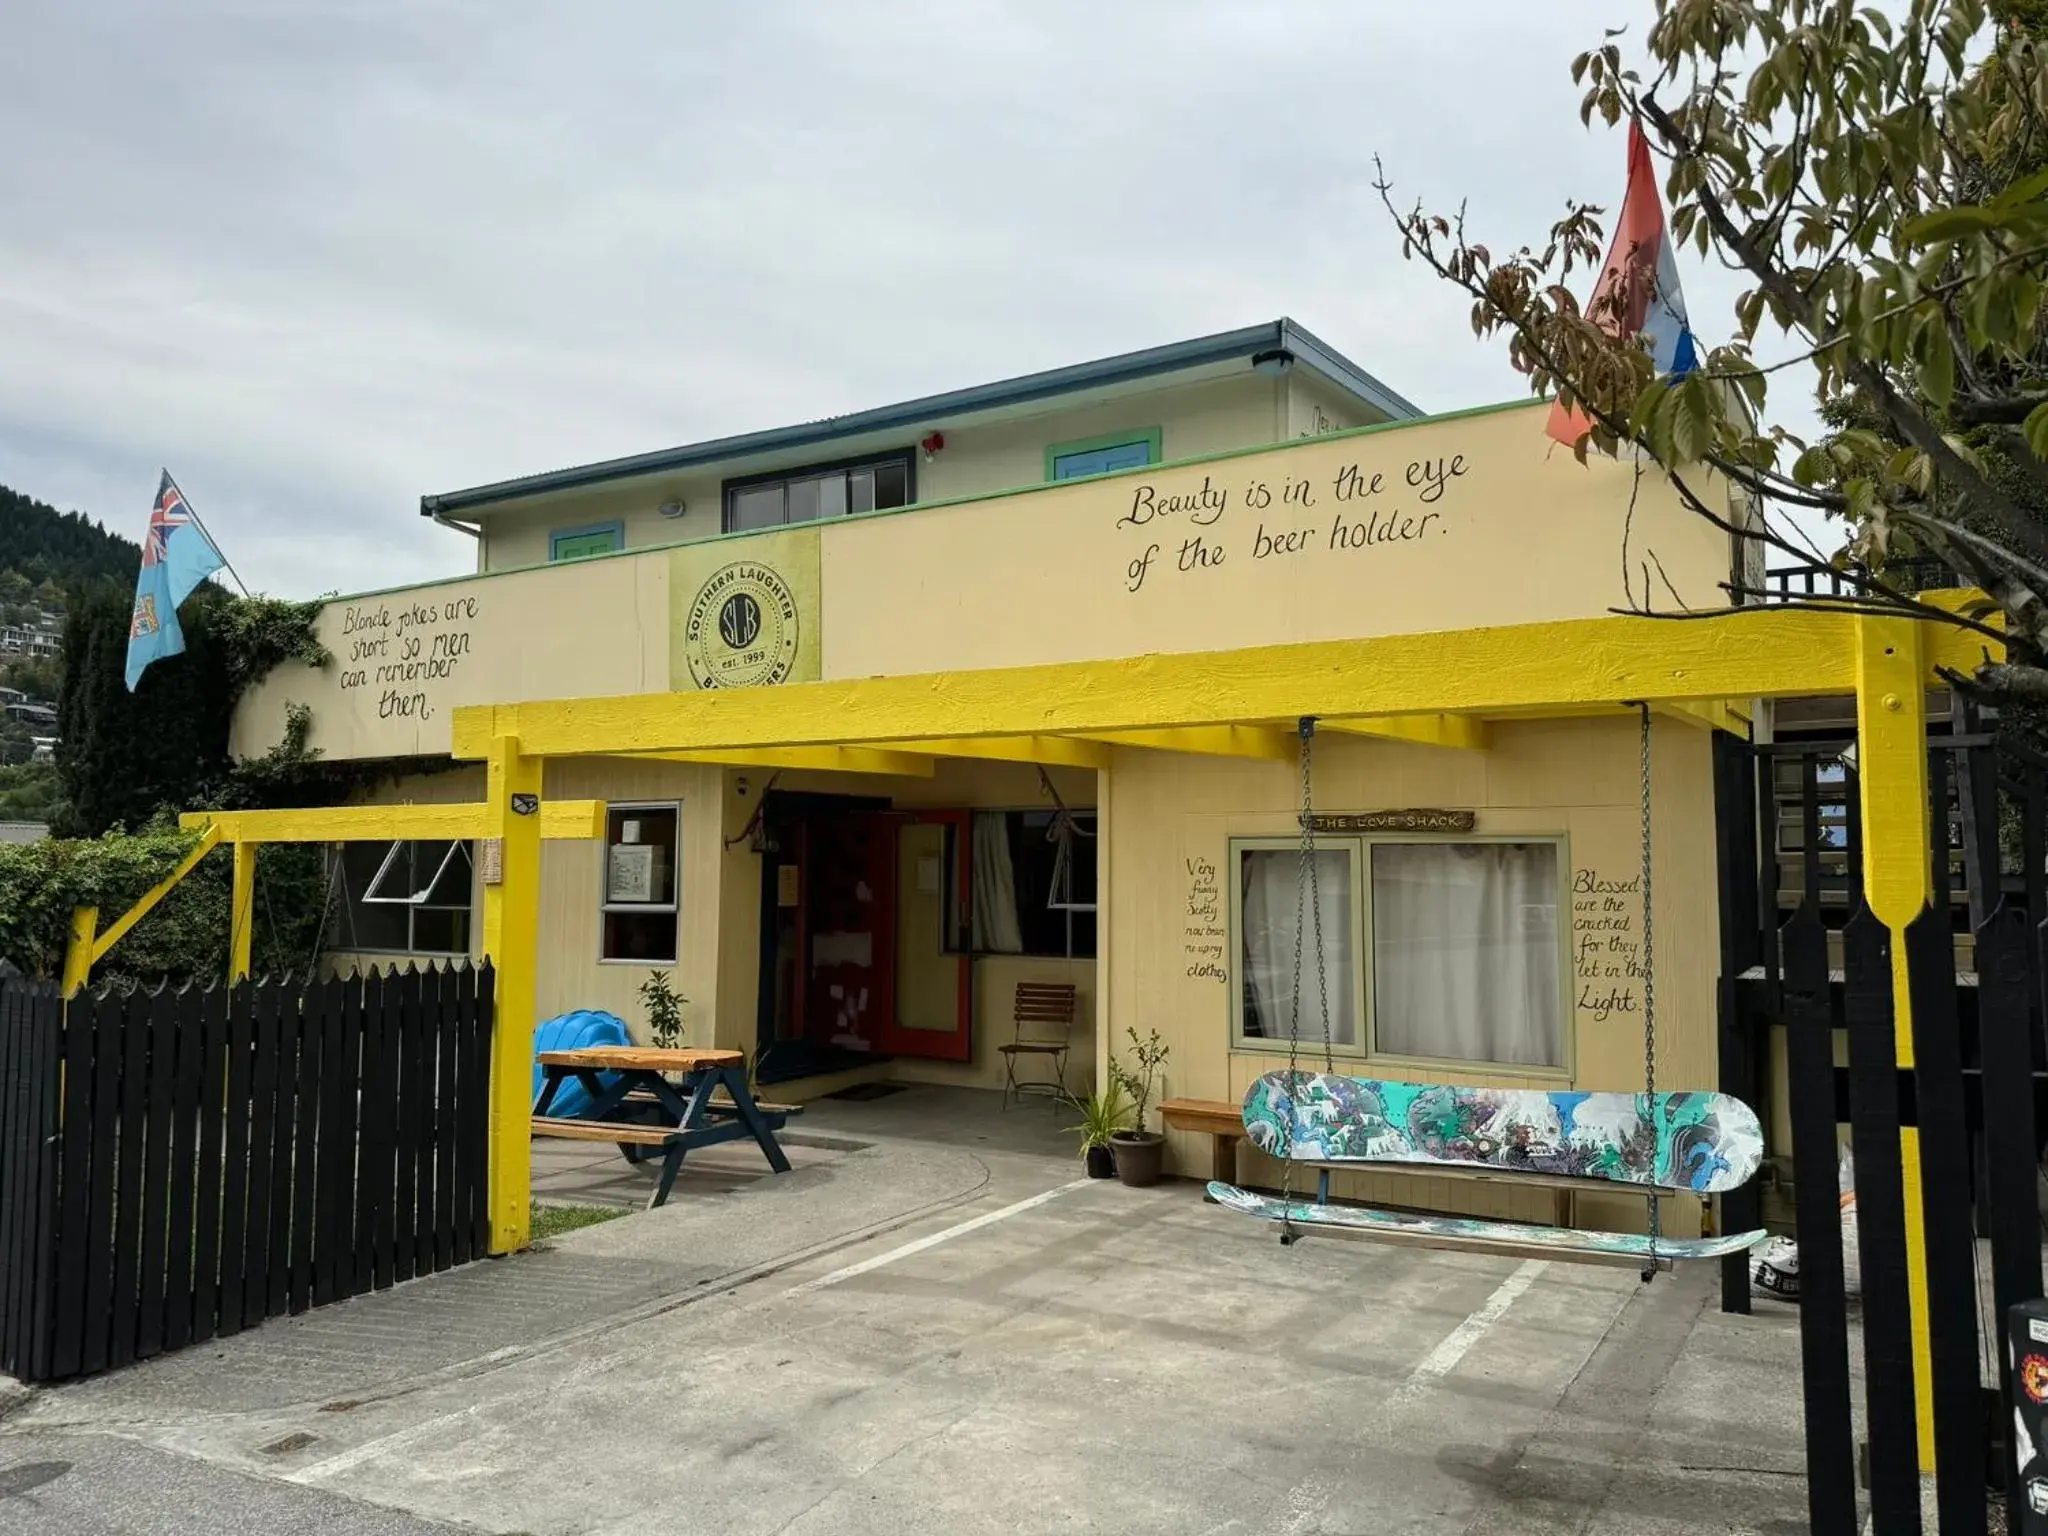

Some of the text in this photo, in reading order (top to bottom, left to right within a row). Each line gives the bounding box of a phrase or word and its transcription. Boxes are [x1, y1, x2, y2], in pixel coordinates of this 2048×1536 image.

[1116, 453, 1470, 528] Beauty is in the eye
[1126, 510, 1448, 593] of the beer holder.
[342, 597, 479, 637] Blonde jokes are
[689, 567, 794, 642] SOUTHERN LAUGHTER
[350, 632, 470, 662] short so men
[743, 651, 766, 665] 1999
[340, 656, 457, 689] can remember
[378, 689, 435, 720] them.
[1316, 815, 1460, 829] THE LOVE SHACK
[1186, 856, 1215, 885] Very
[1573, 869, 1640, 893] Blessed
[1575, 897, 1624, 912] are the
[1574, 915, 1630, 931] cracked
[1575, 933, 1637, 963] for they
[1577, 959, 1600, 978] let
[1605, 962, 1620, 978] in
